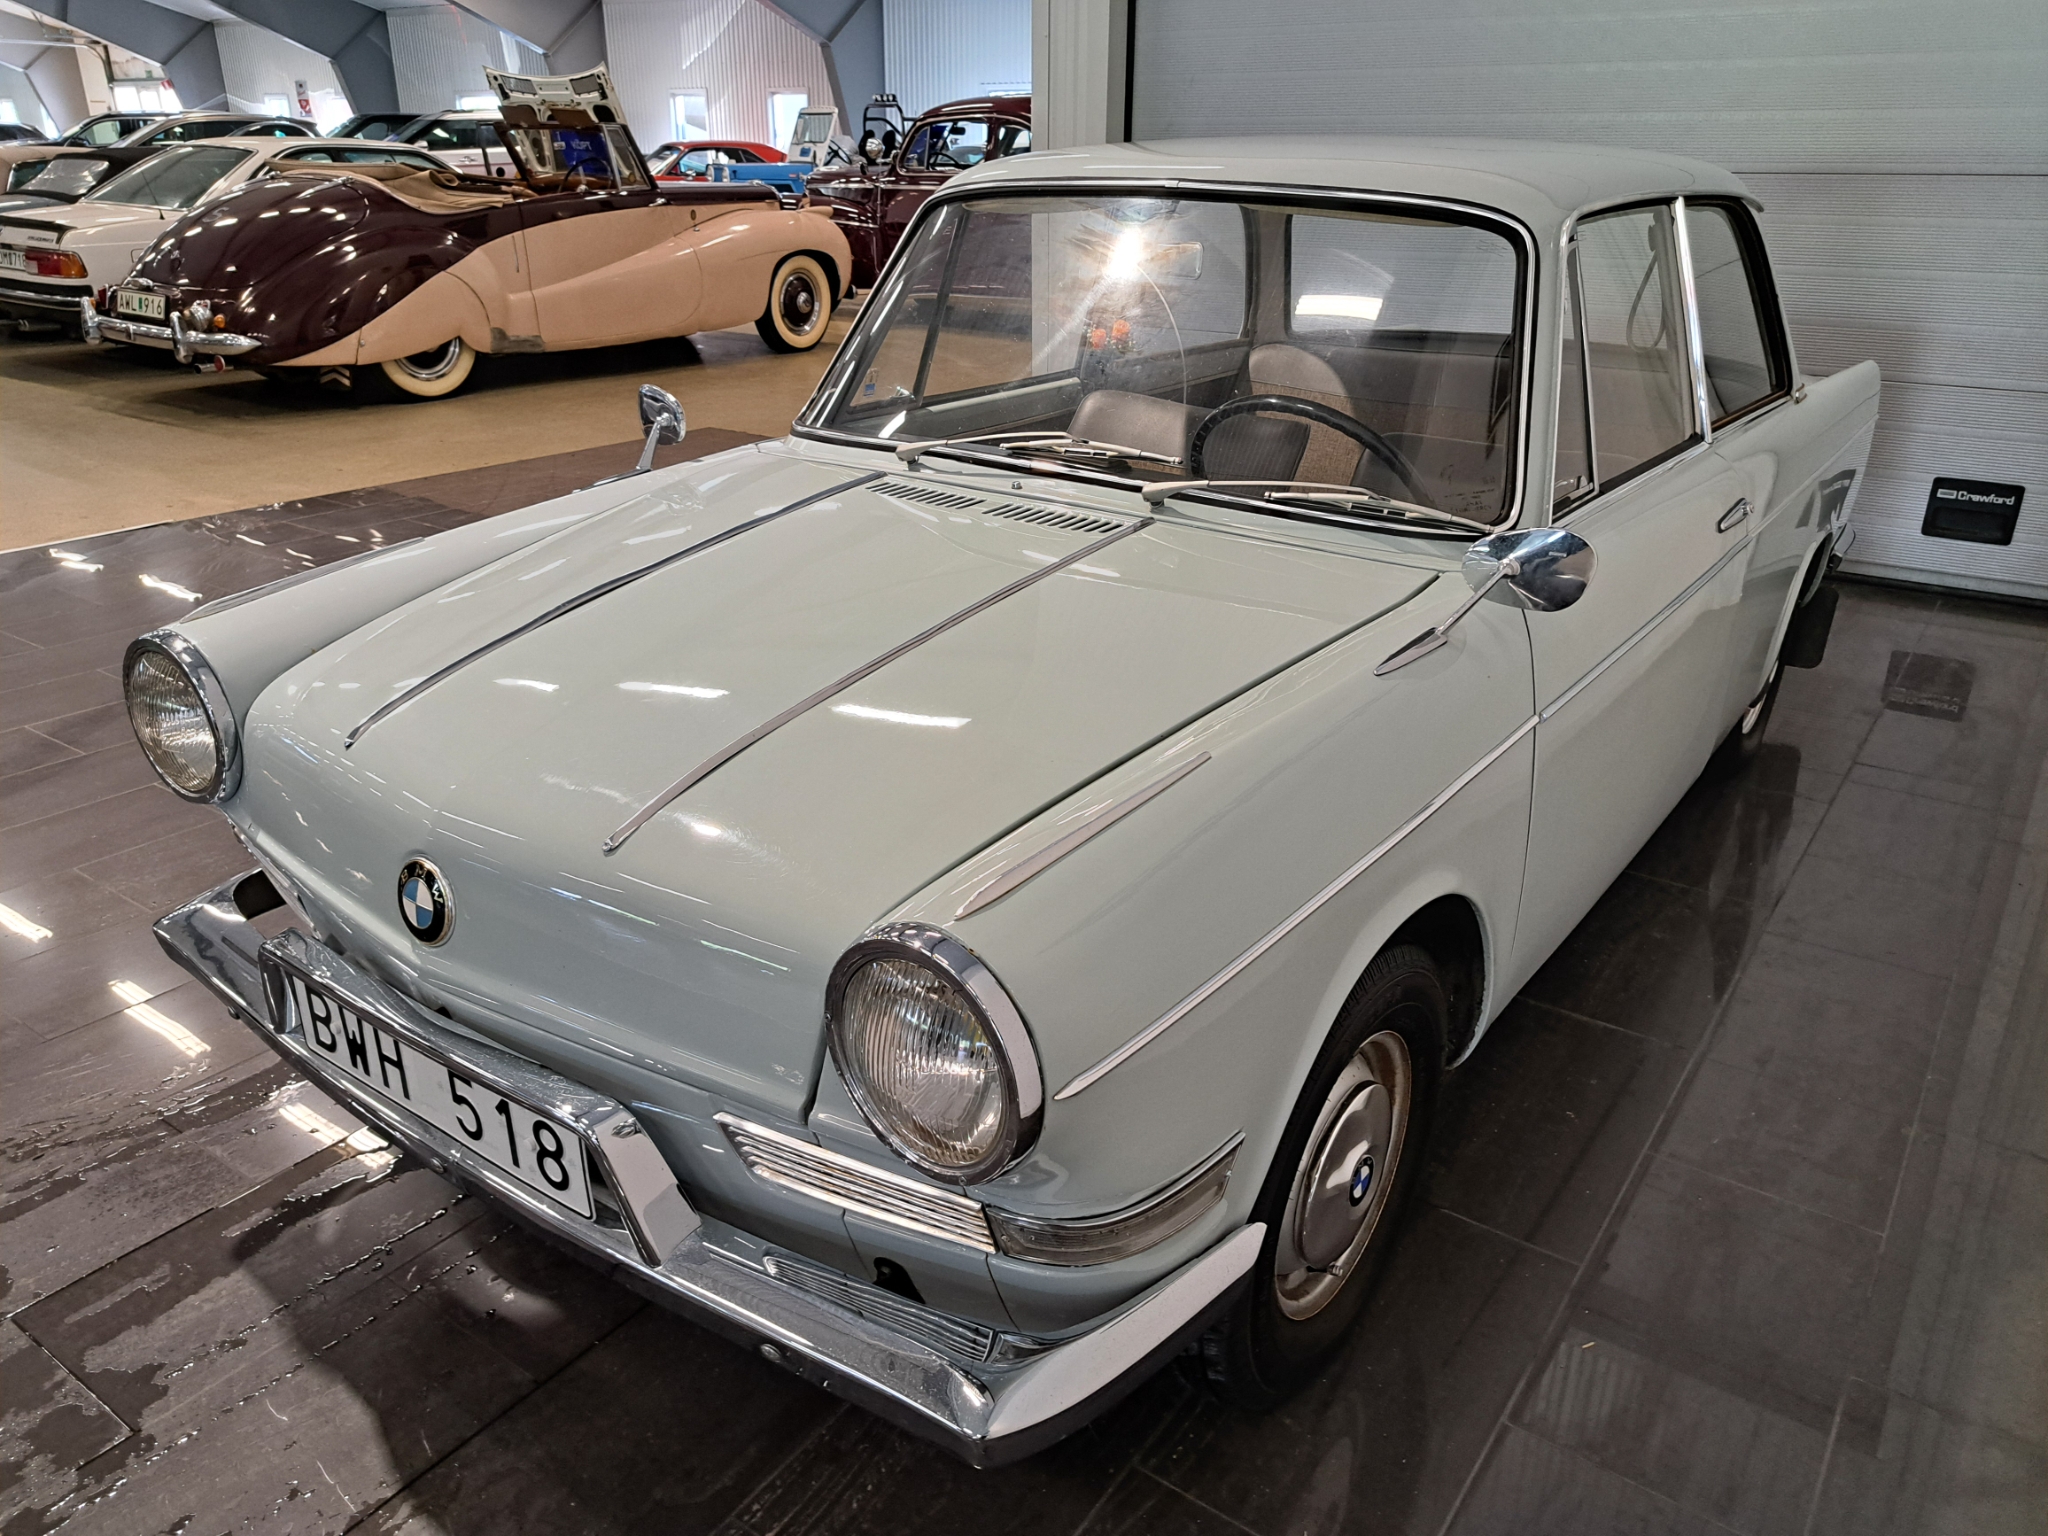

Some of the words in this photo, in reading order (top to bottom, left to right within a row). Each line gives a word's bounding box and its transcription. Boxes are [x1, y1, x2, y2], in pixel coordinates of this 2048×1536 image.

[119, 293, 137, 312] AWL
[144, 297, 163, 316] 916
[1957, 491, 2015, 506] Crawford
[401, 864, 444, 904] BMW
[305, 986, 411, 1101] BWH
[448, 1068, 570, 1192] 518
